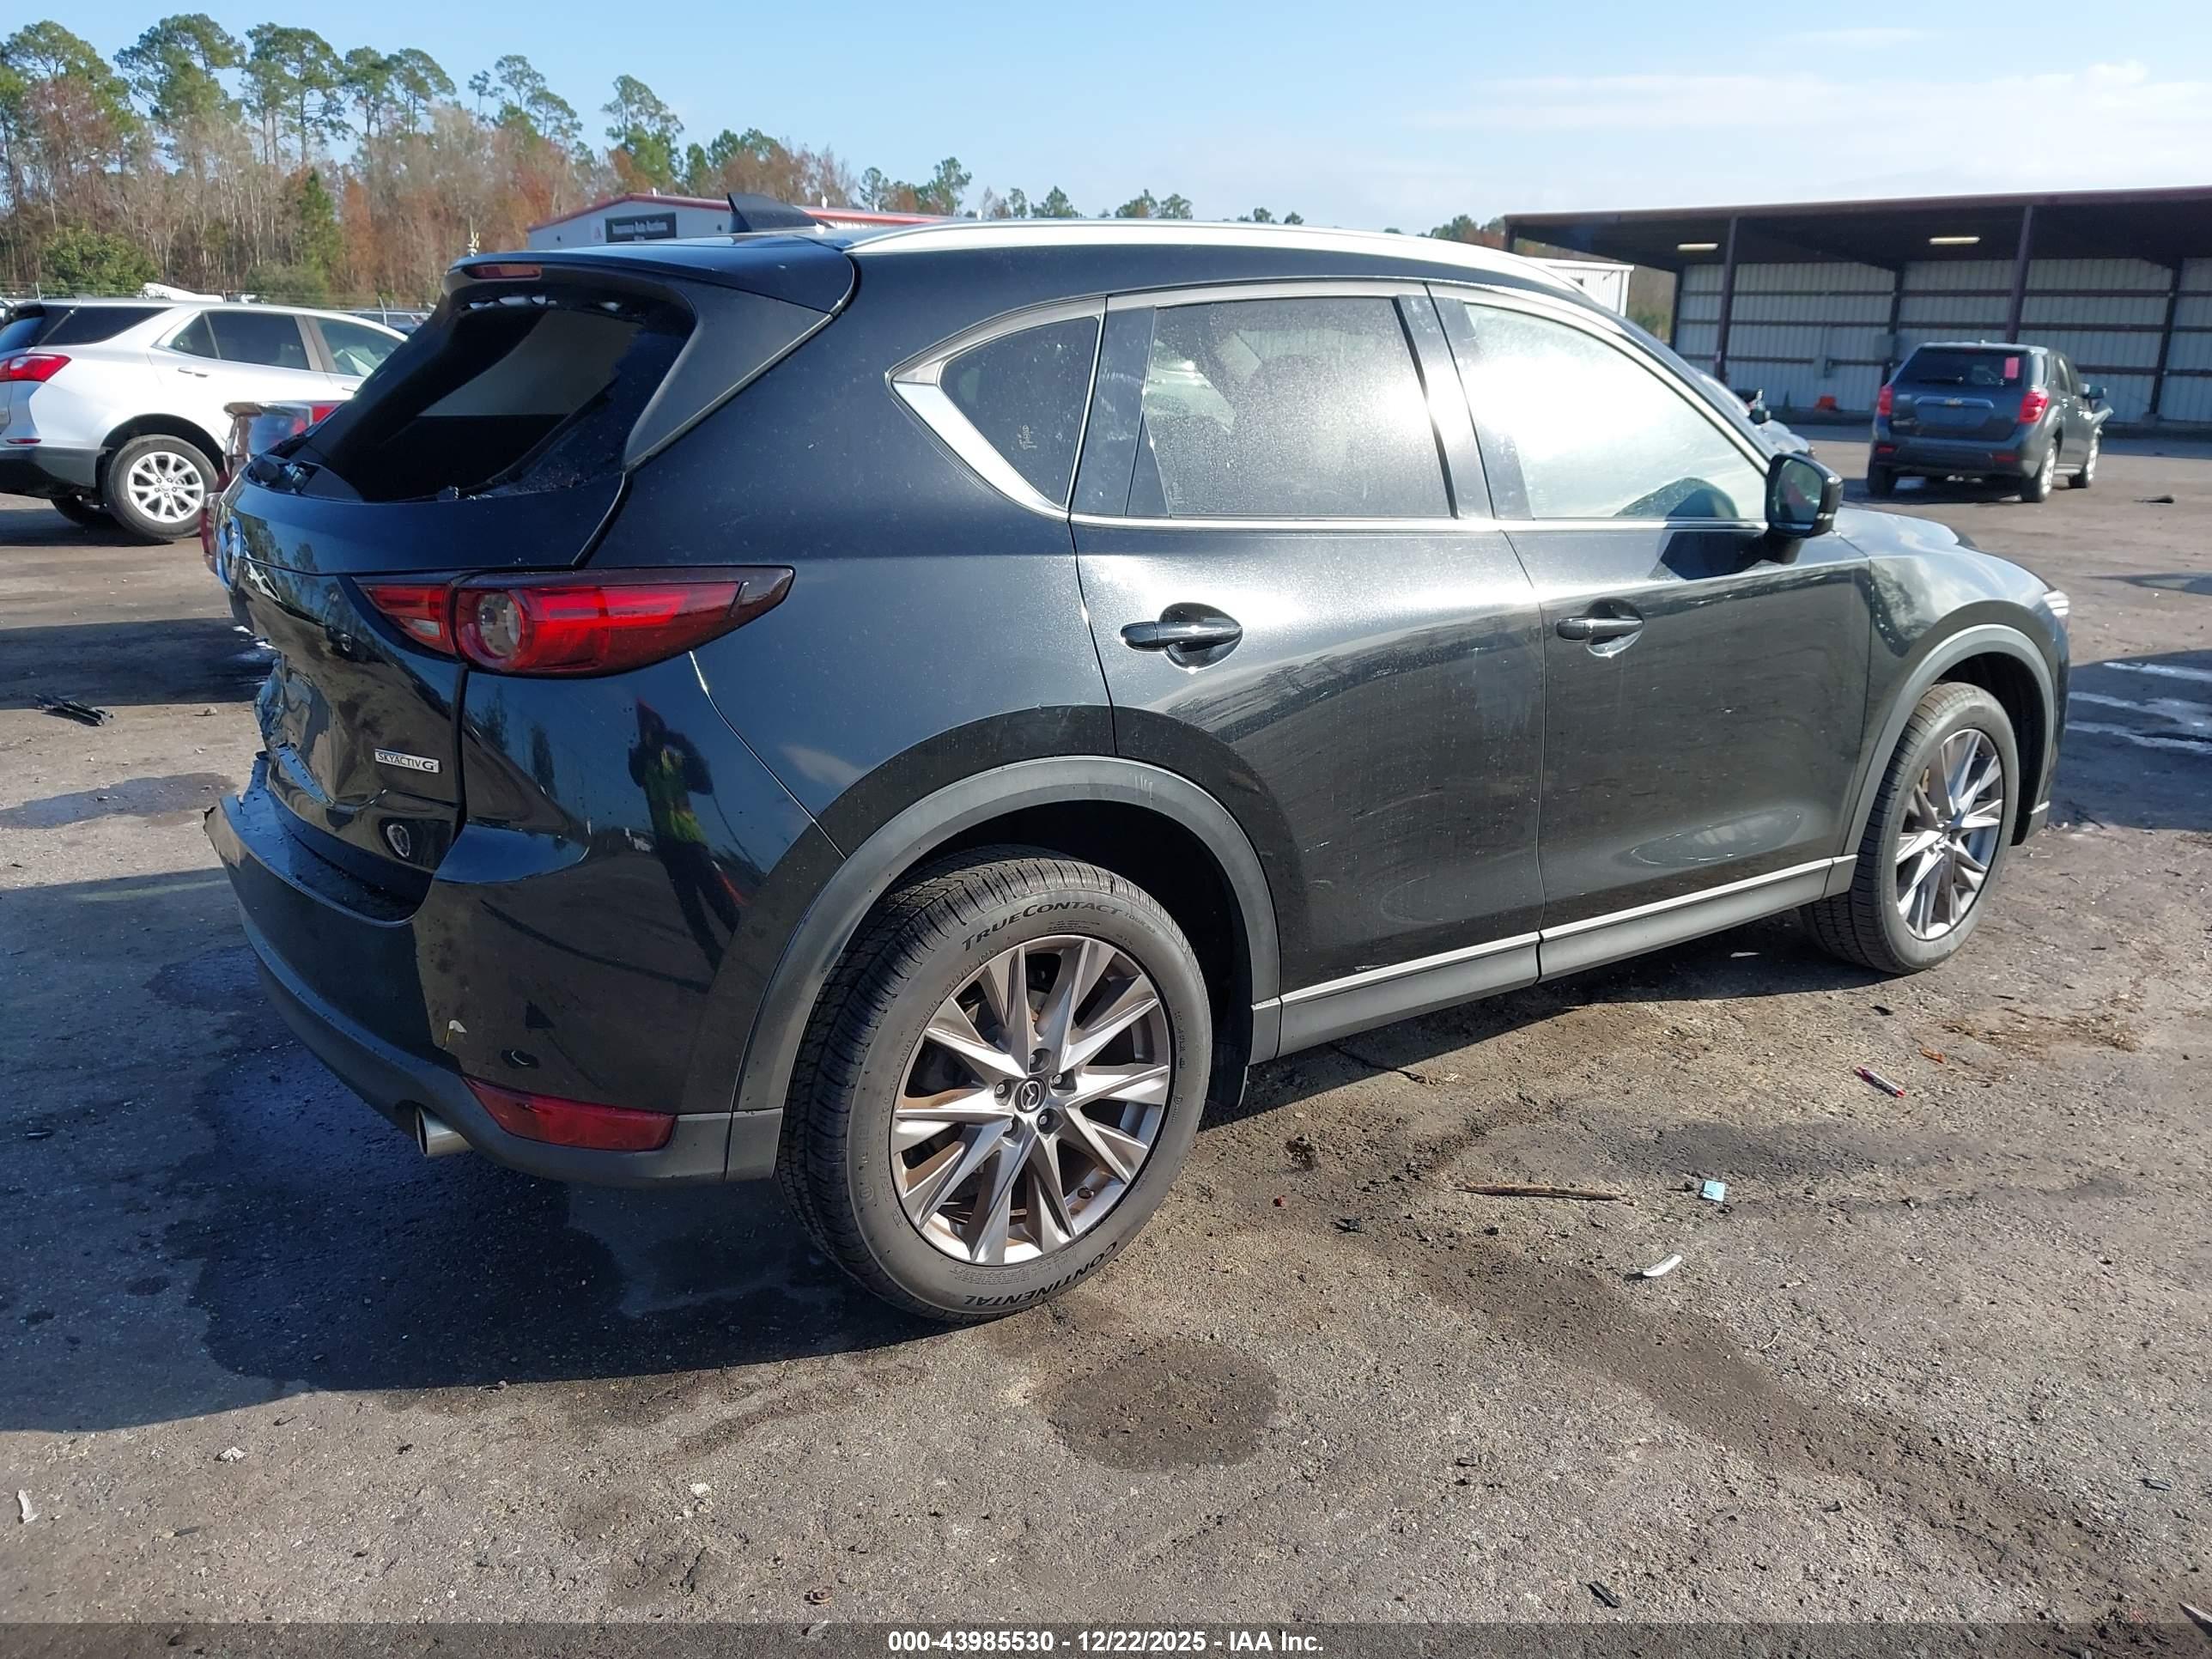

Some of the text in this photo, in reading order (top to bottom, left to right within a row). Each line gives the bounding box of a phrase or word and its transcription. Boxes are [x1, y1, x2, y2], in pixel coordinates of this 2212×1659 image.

[378, 752, 434, 770] SKYACTIV G
[964, 1241, 1118, 1306] CONTINENTAL
